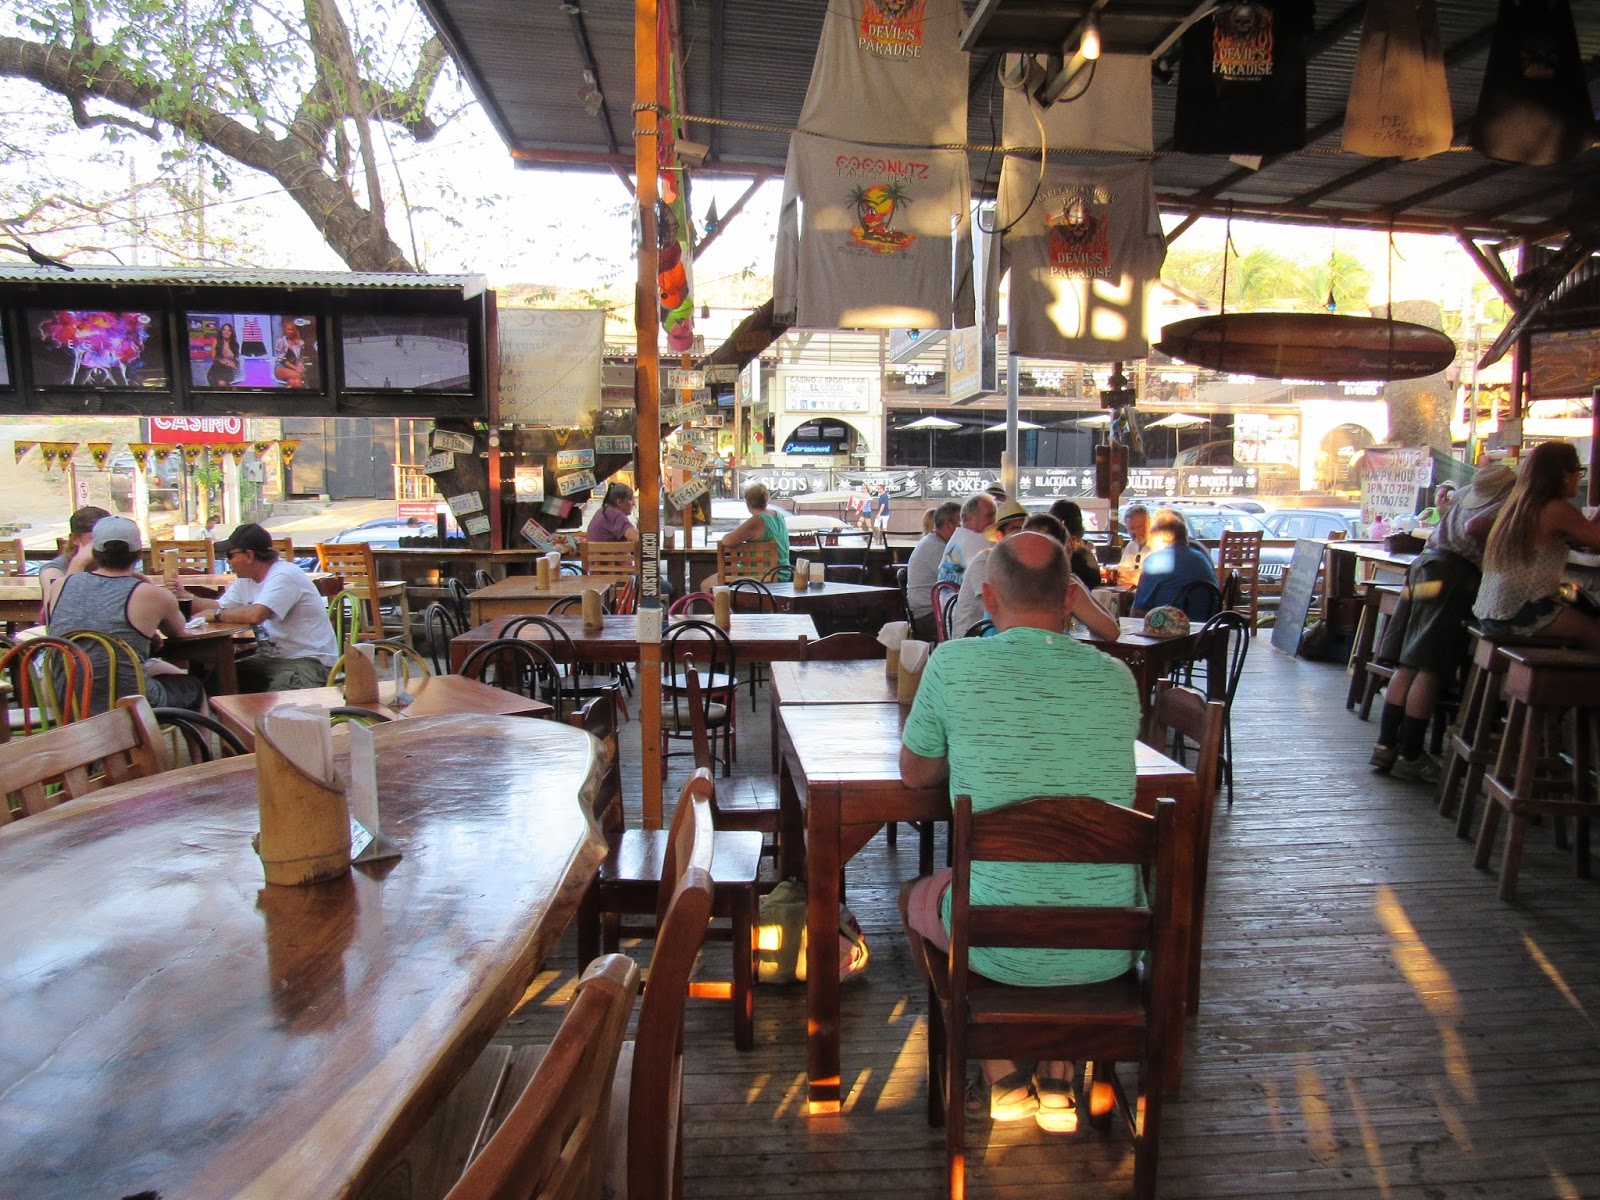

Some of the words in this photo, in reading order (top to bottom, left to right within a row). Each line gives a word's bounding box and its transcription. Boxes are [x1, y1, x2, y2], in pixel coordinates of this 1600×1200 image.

[868, 24, 915, 41] DEVIL'S
[858, 37, 922, 58] PARADISE
[1219, 47, 1265, 60] DEVIL'S
[1212, 60, 1273, 76] PARADISE
[836, 155, 929, 179] COCONUTZ
[1035, 185, 1070, 204] HARLEY
[1057, 252, 1103, 264] DEVIL'S
[1050, 265, 1112, 278] PARADISE
[790, 376, 817, 384] CASINO
[905, 375, 928, 385] BAR
[1034, 378, 1061, 389] JACK
[153, 418, 241, 434] CASINO
[786, 443, 831, 453] Entertainment
[1034, 476, 1077, 488] BLACKJACK
[1125, 475, 1165, 489] OULETTE
[1365, 469, 1392, 482] HAPPY
[561, 480, 576, 491] 579
[761, 477, 808, 491] SLOTS
[946, 479, 990, 491] POKER
[1397, 485, 1415, 495] 7PM
[641, 533, 657, 559] OCCUPY
